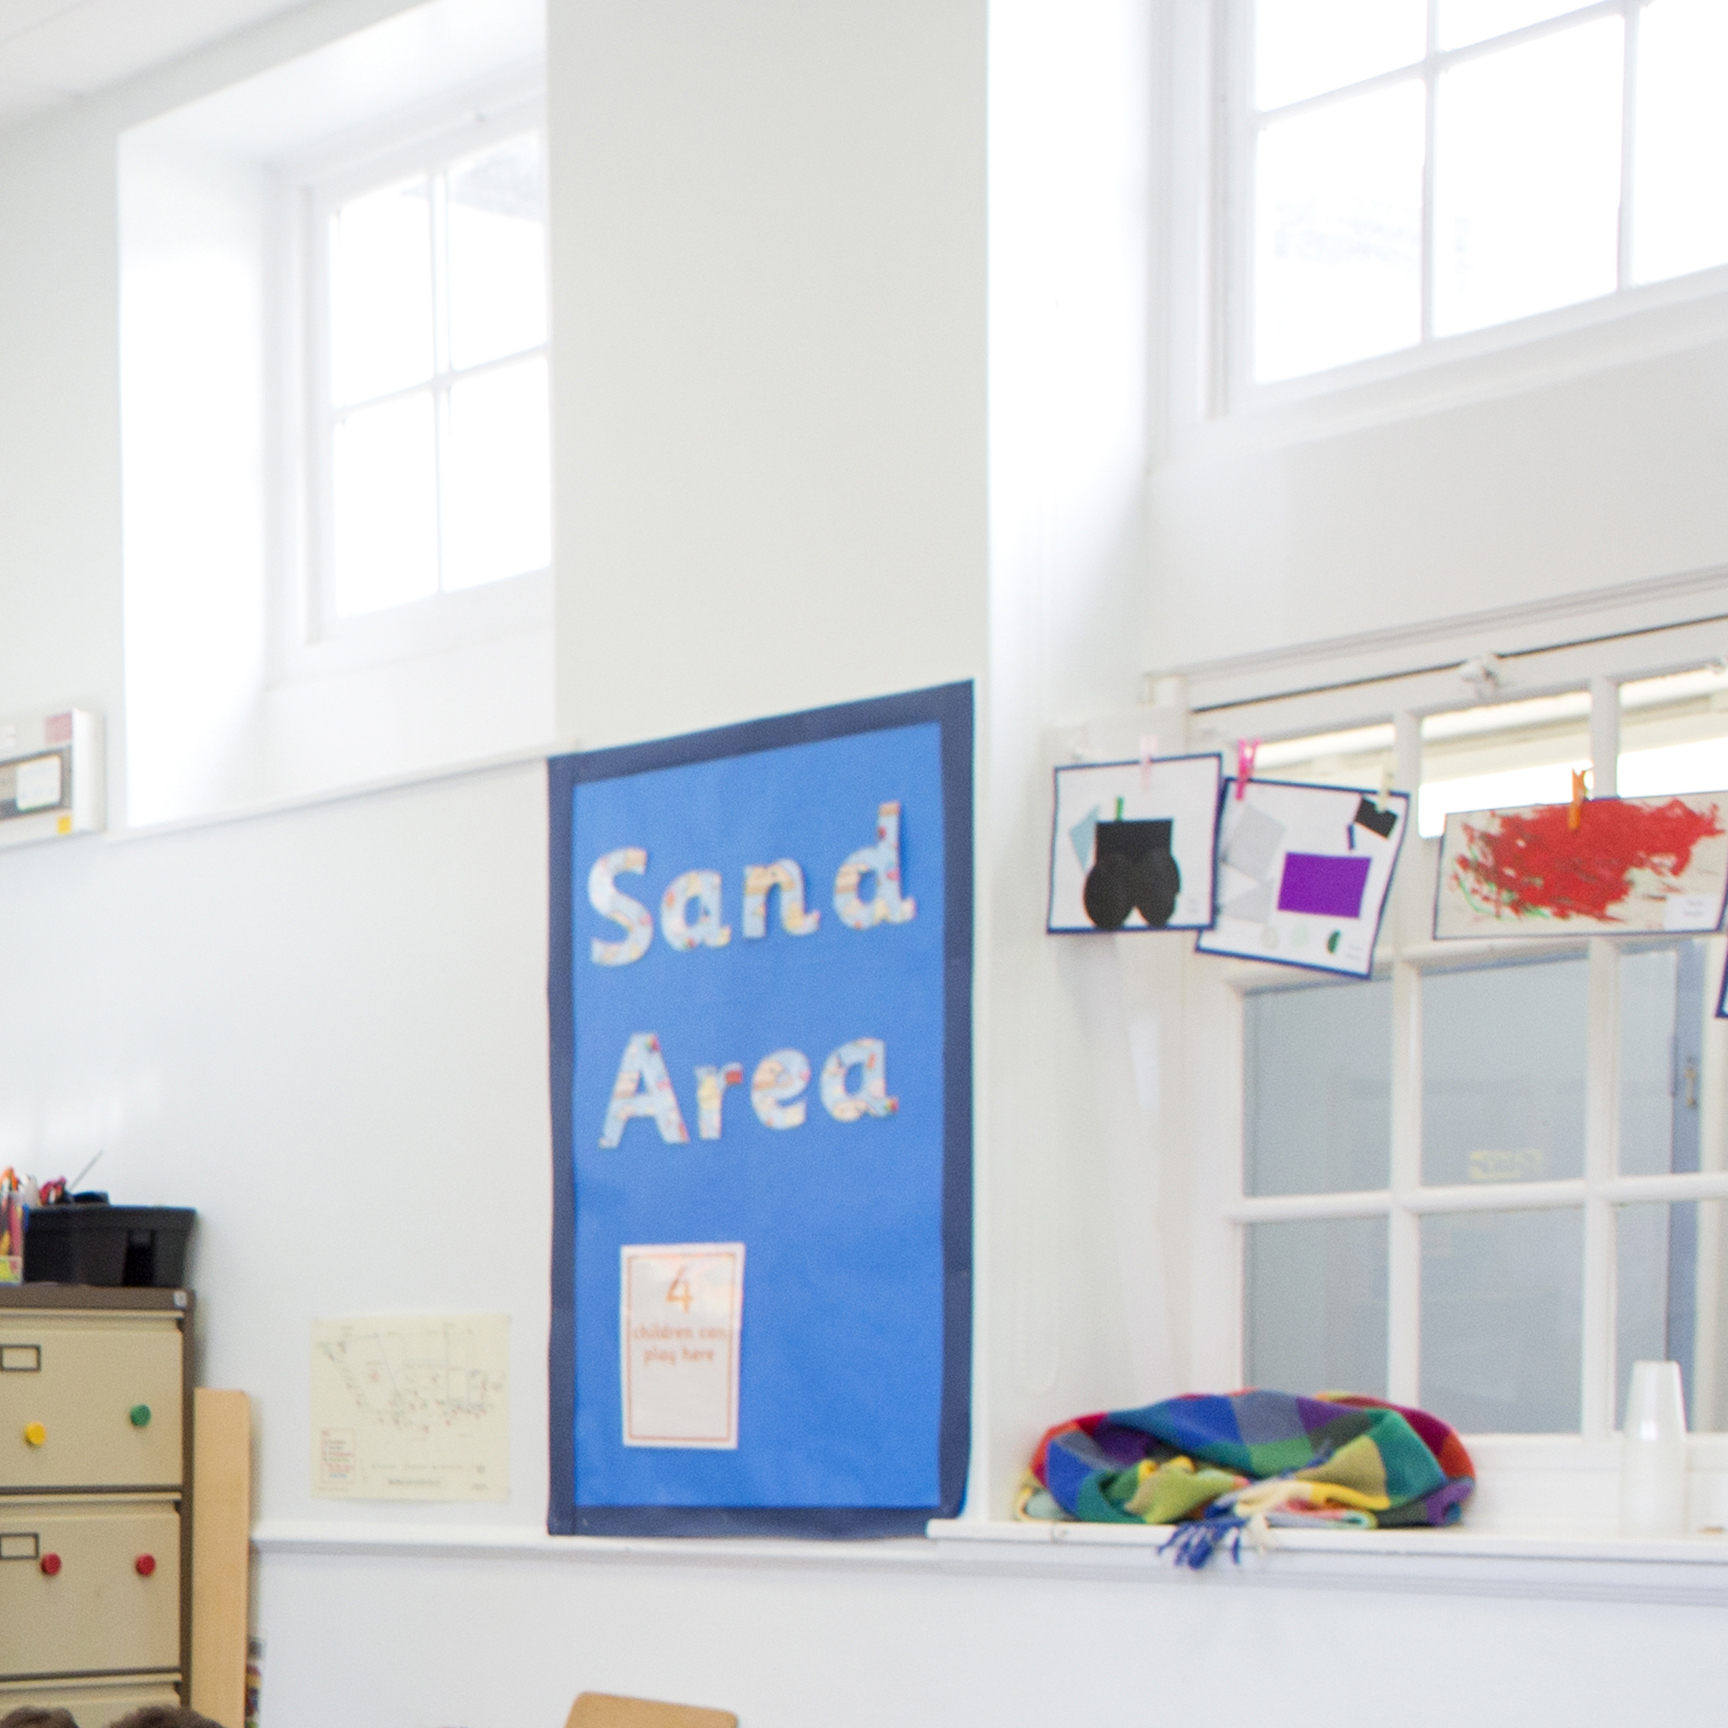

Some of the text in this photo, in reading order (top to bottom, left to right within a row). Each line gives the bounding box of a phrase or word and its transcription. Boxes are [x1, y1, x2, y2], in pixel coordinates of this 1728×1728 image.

[588, 800, 917, 967] Sand
[598, 1032, 899, 1150] Area
[666, 1266, 693, 1314] 4
[633, 1322, 693, 1340] children
[644, 1347, 714, 1367] play here
